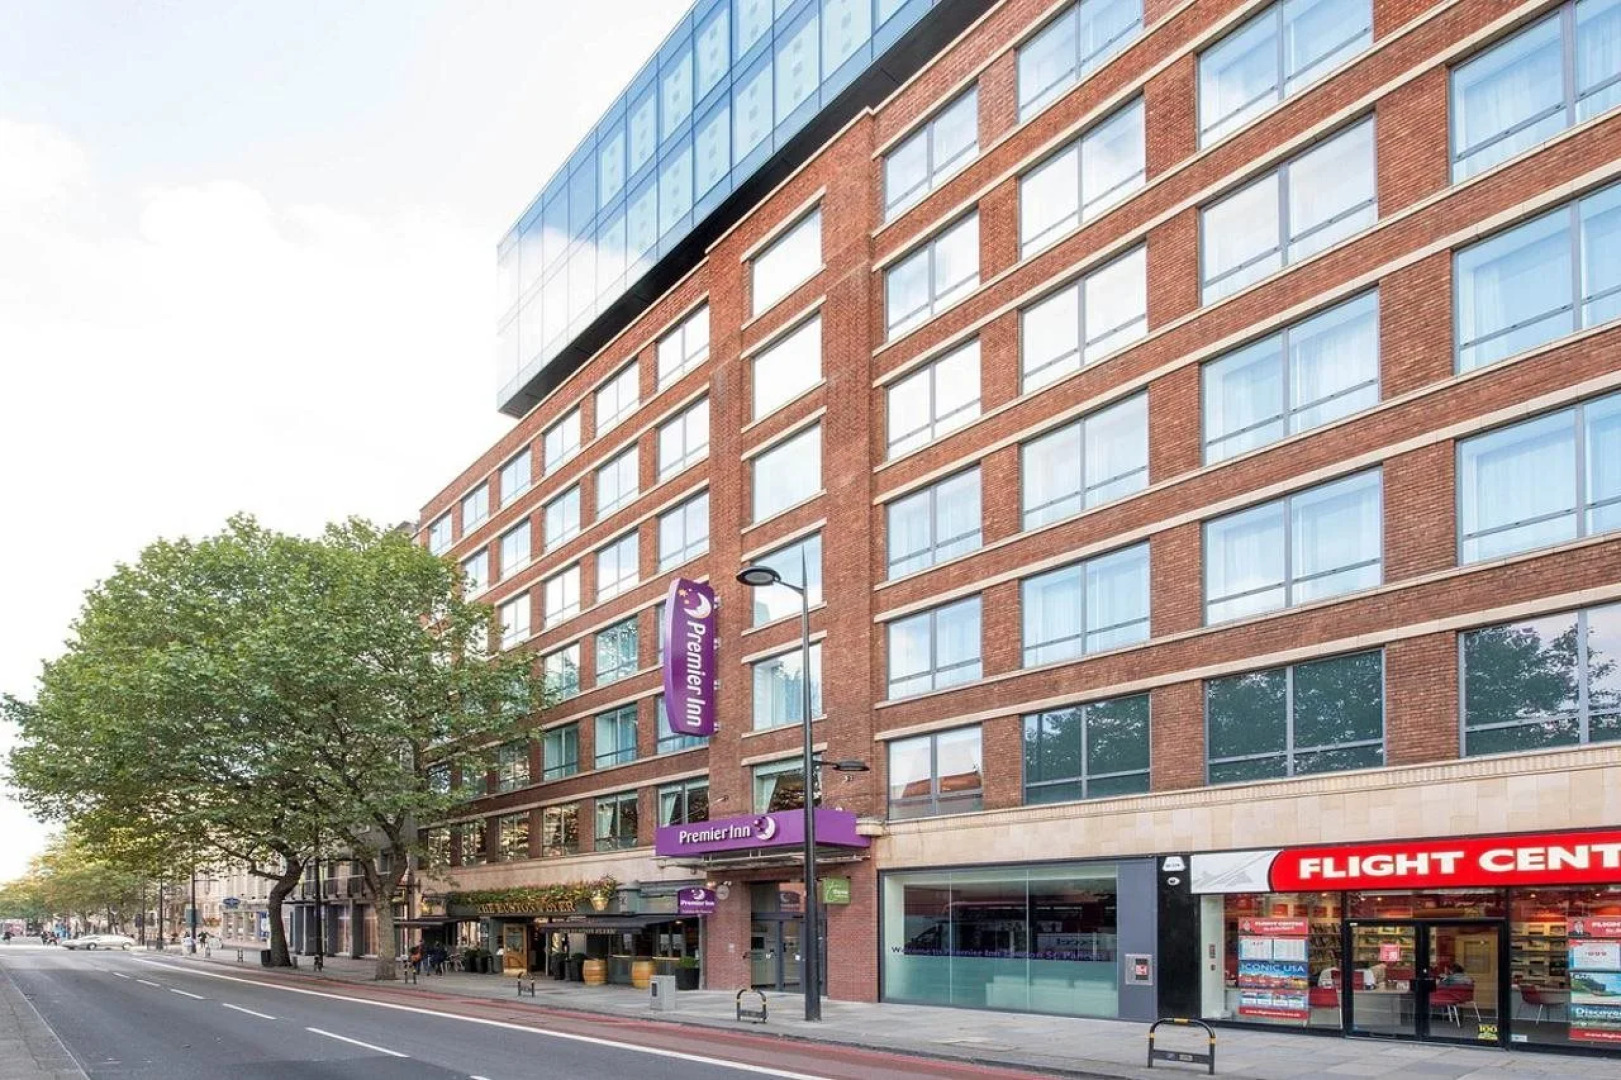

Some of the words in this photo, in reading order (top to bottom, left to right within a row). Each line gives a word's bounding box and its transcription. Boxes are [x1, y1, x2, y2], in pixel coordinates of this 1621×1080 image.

[686, 620, 706, 695] Premier
[686, 697, 706, 727] Inn
[679, 826, 727, 844] Premier
[730, 824, 751, 838] Inn
[1299, 851, 1465, 880] FLIGHT
[1478, 843, 1621, 873] CENT
[1241, 963, 1281, 972] ICONIC
[1283, 964, 1305, 972] USA
